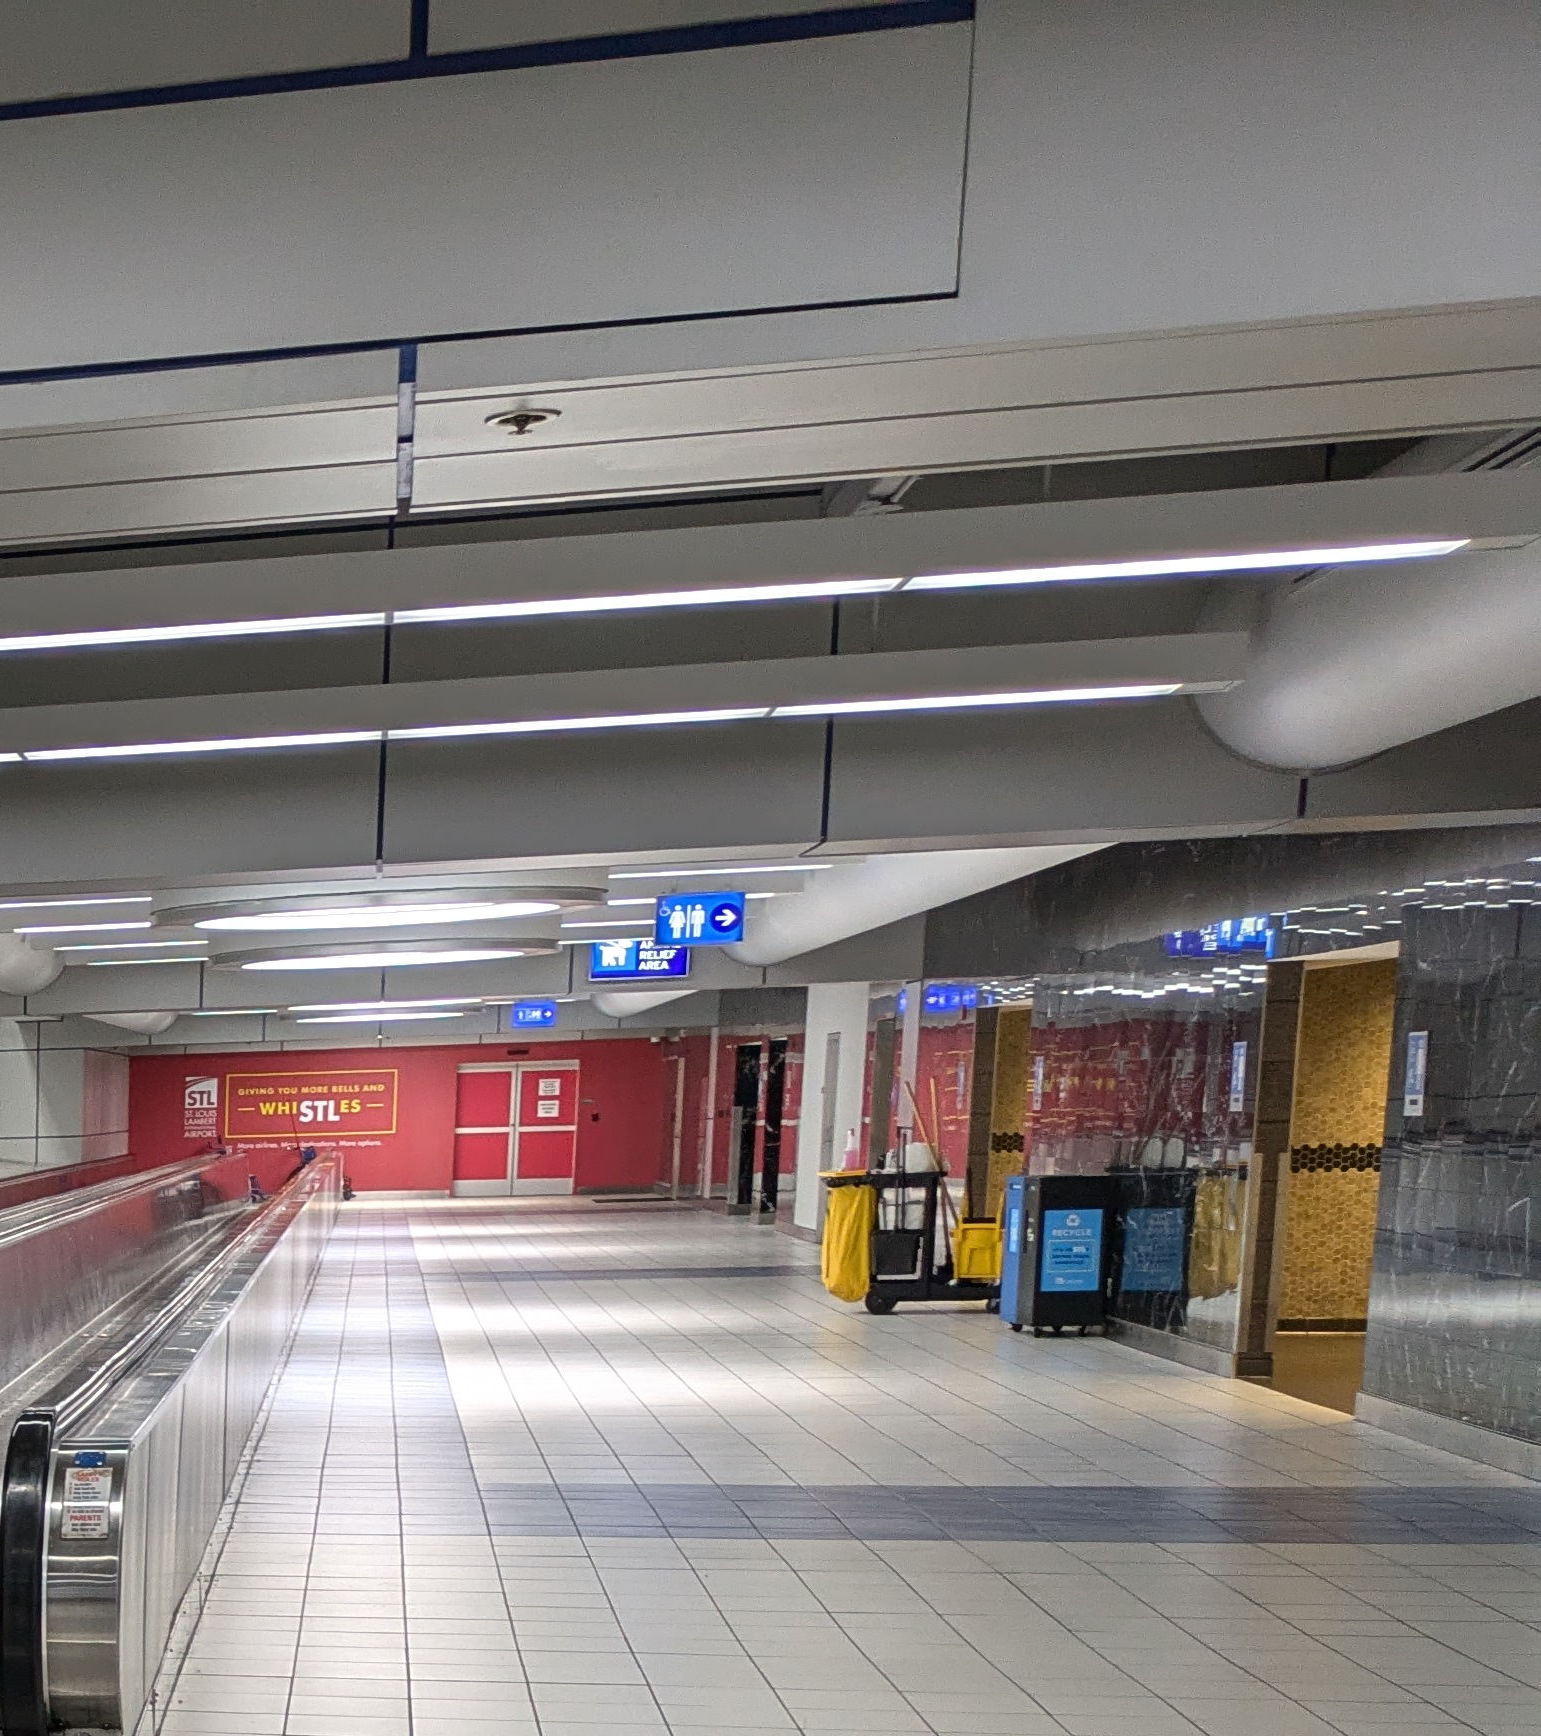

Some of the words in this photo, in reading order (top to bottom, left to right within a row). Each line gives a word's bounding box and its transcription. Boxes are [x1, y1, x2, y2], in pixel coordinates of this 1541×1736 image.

[638, 961, 669, 971] AREA
[237, 1087, 275, 1096] GIVING
[278, 1086, 297, 1095] YOU
[301, 1086, 328, 1094] MORE
[332, 1084, 360, 1093] BELLS
[363, 1083, 385, 1093] AND
[187, 1090, 215, 1106] STL
